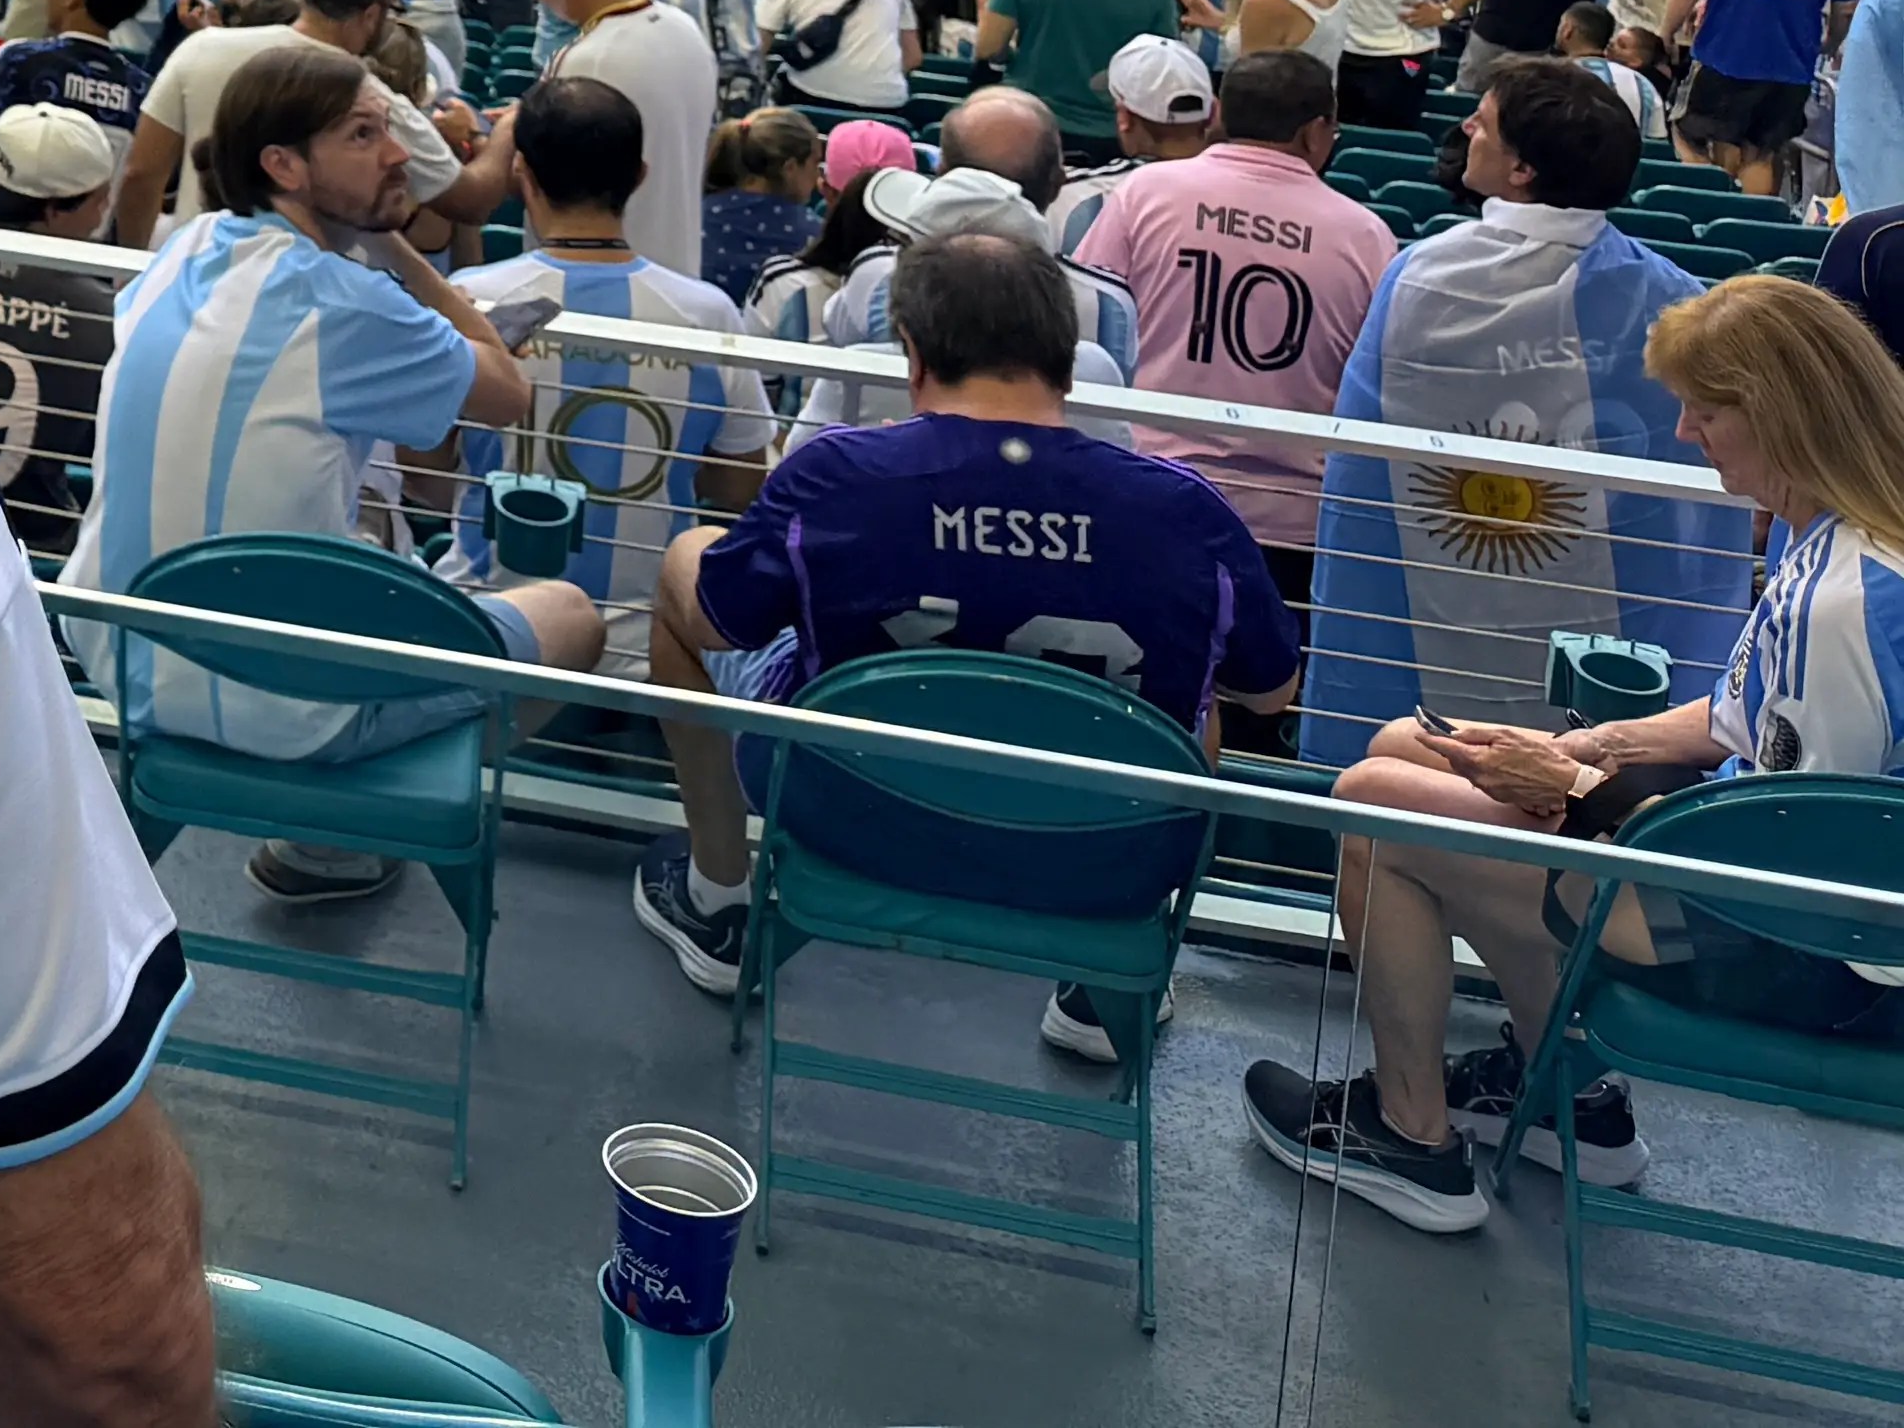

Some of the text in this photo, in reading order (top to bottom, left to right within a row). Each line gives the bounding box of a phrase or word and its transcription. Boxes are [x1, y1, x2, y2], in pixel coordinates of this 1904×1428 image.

[64, 72, 131, 111] MESSI
[1195, 200, 1314, 254] MESSI
[1177, 245, 1314, 374] 10
[932, 502, 1093, 564] MESSI
